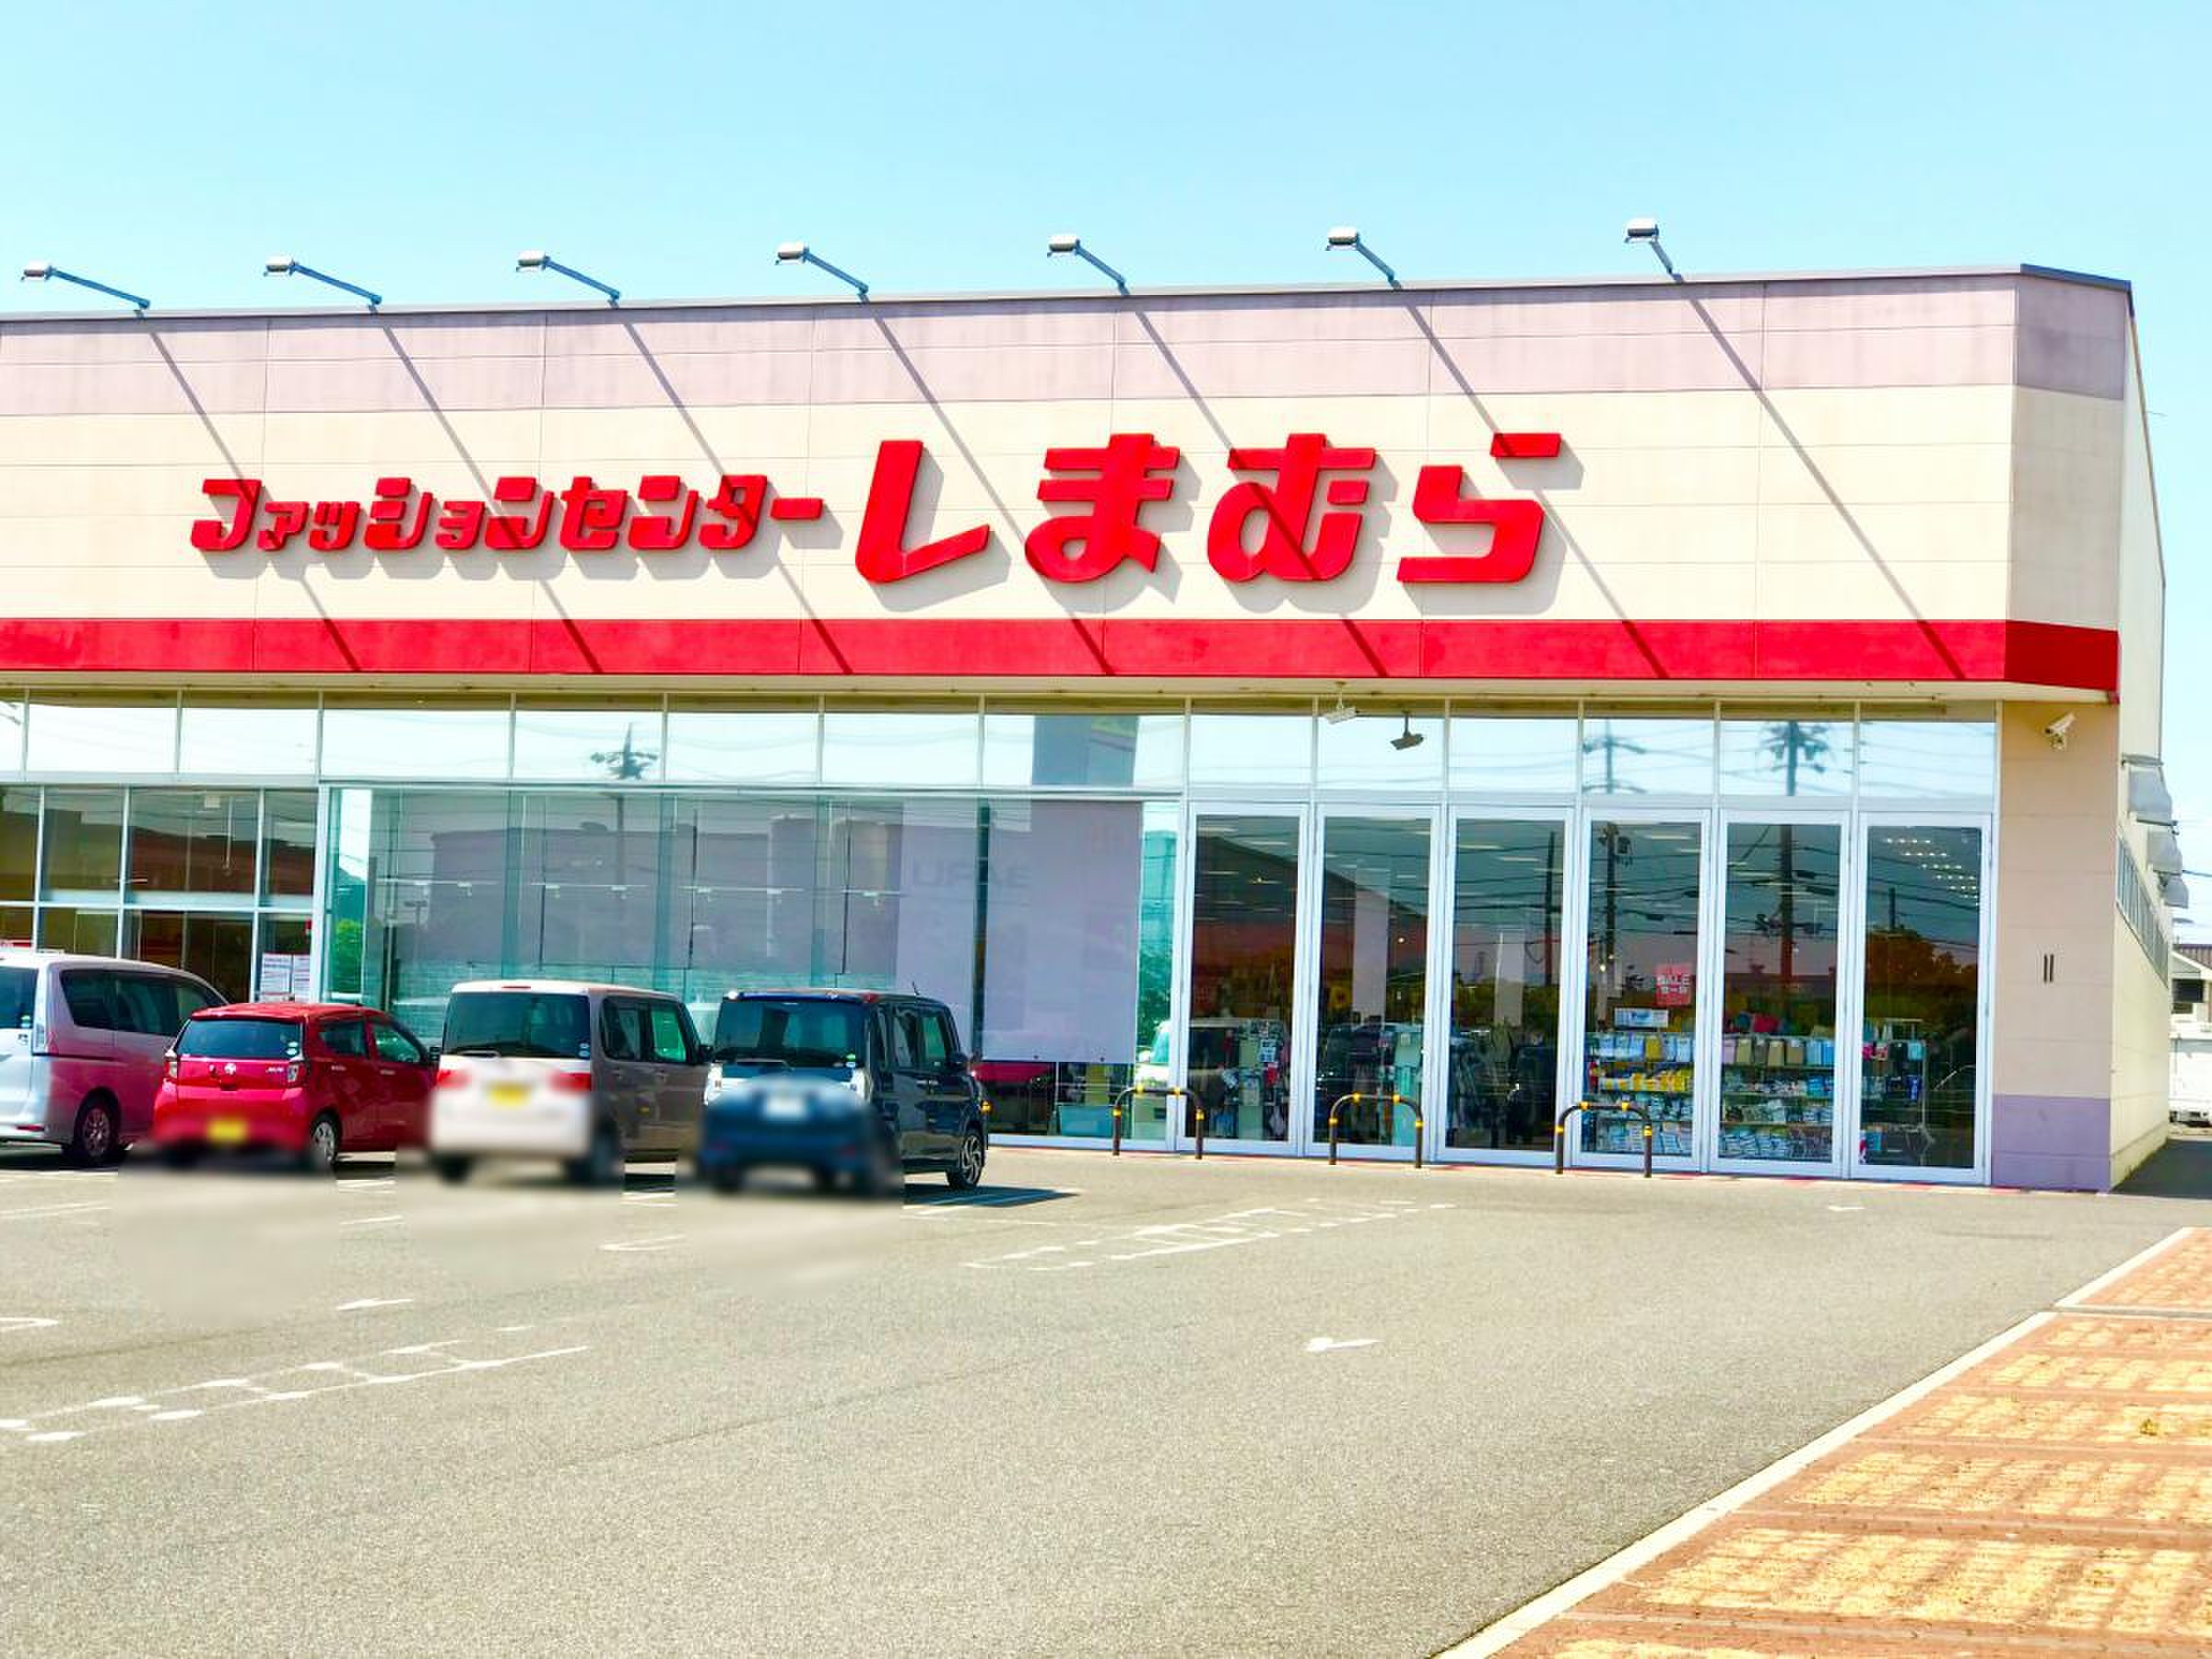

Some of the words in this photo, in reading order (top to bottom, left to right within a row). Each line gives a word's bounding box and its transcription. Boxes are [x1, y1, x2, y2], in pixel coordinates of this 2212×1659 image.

[189, 474, 824, 553] ファッションセンター
[855, 431, 1563, 585] しまむら
